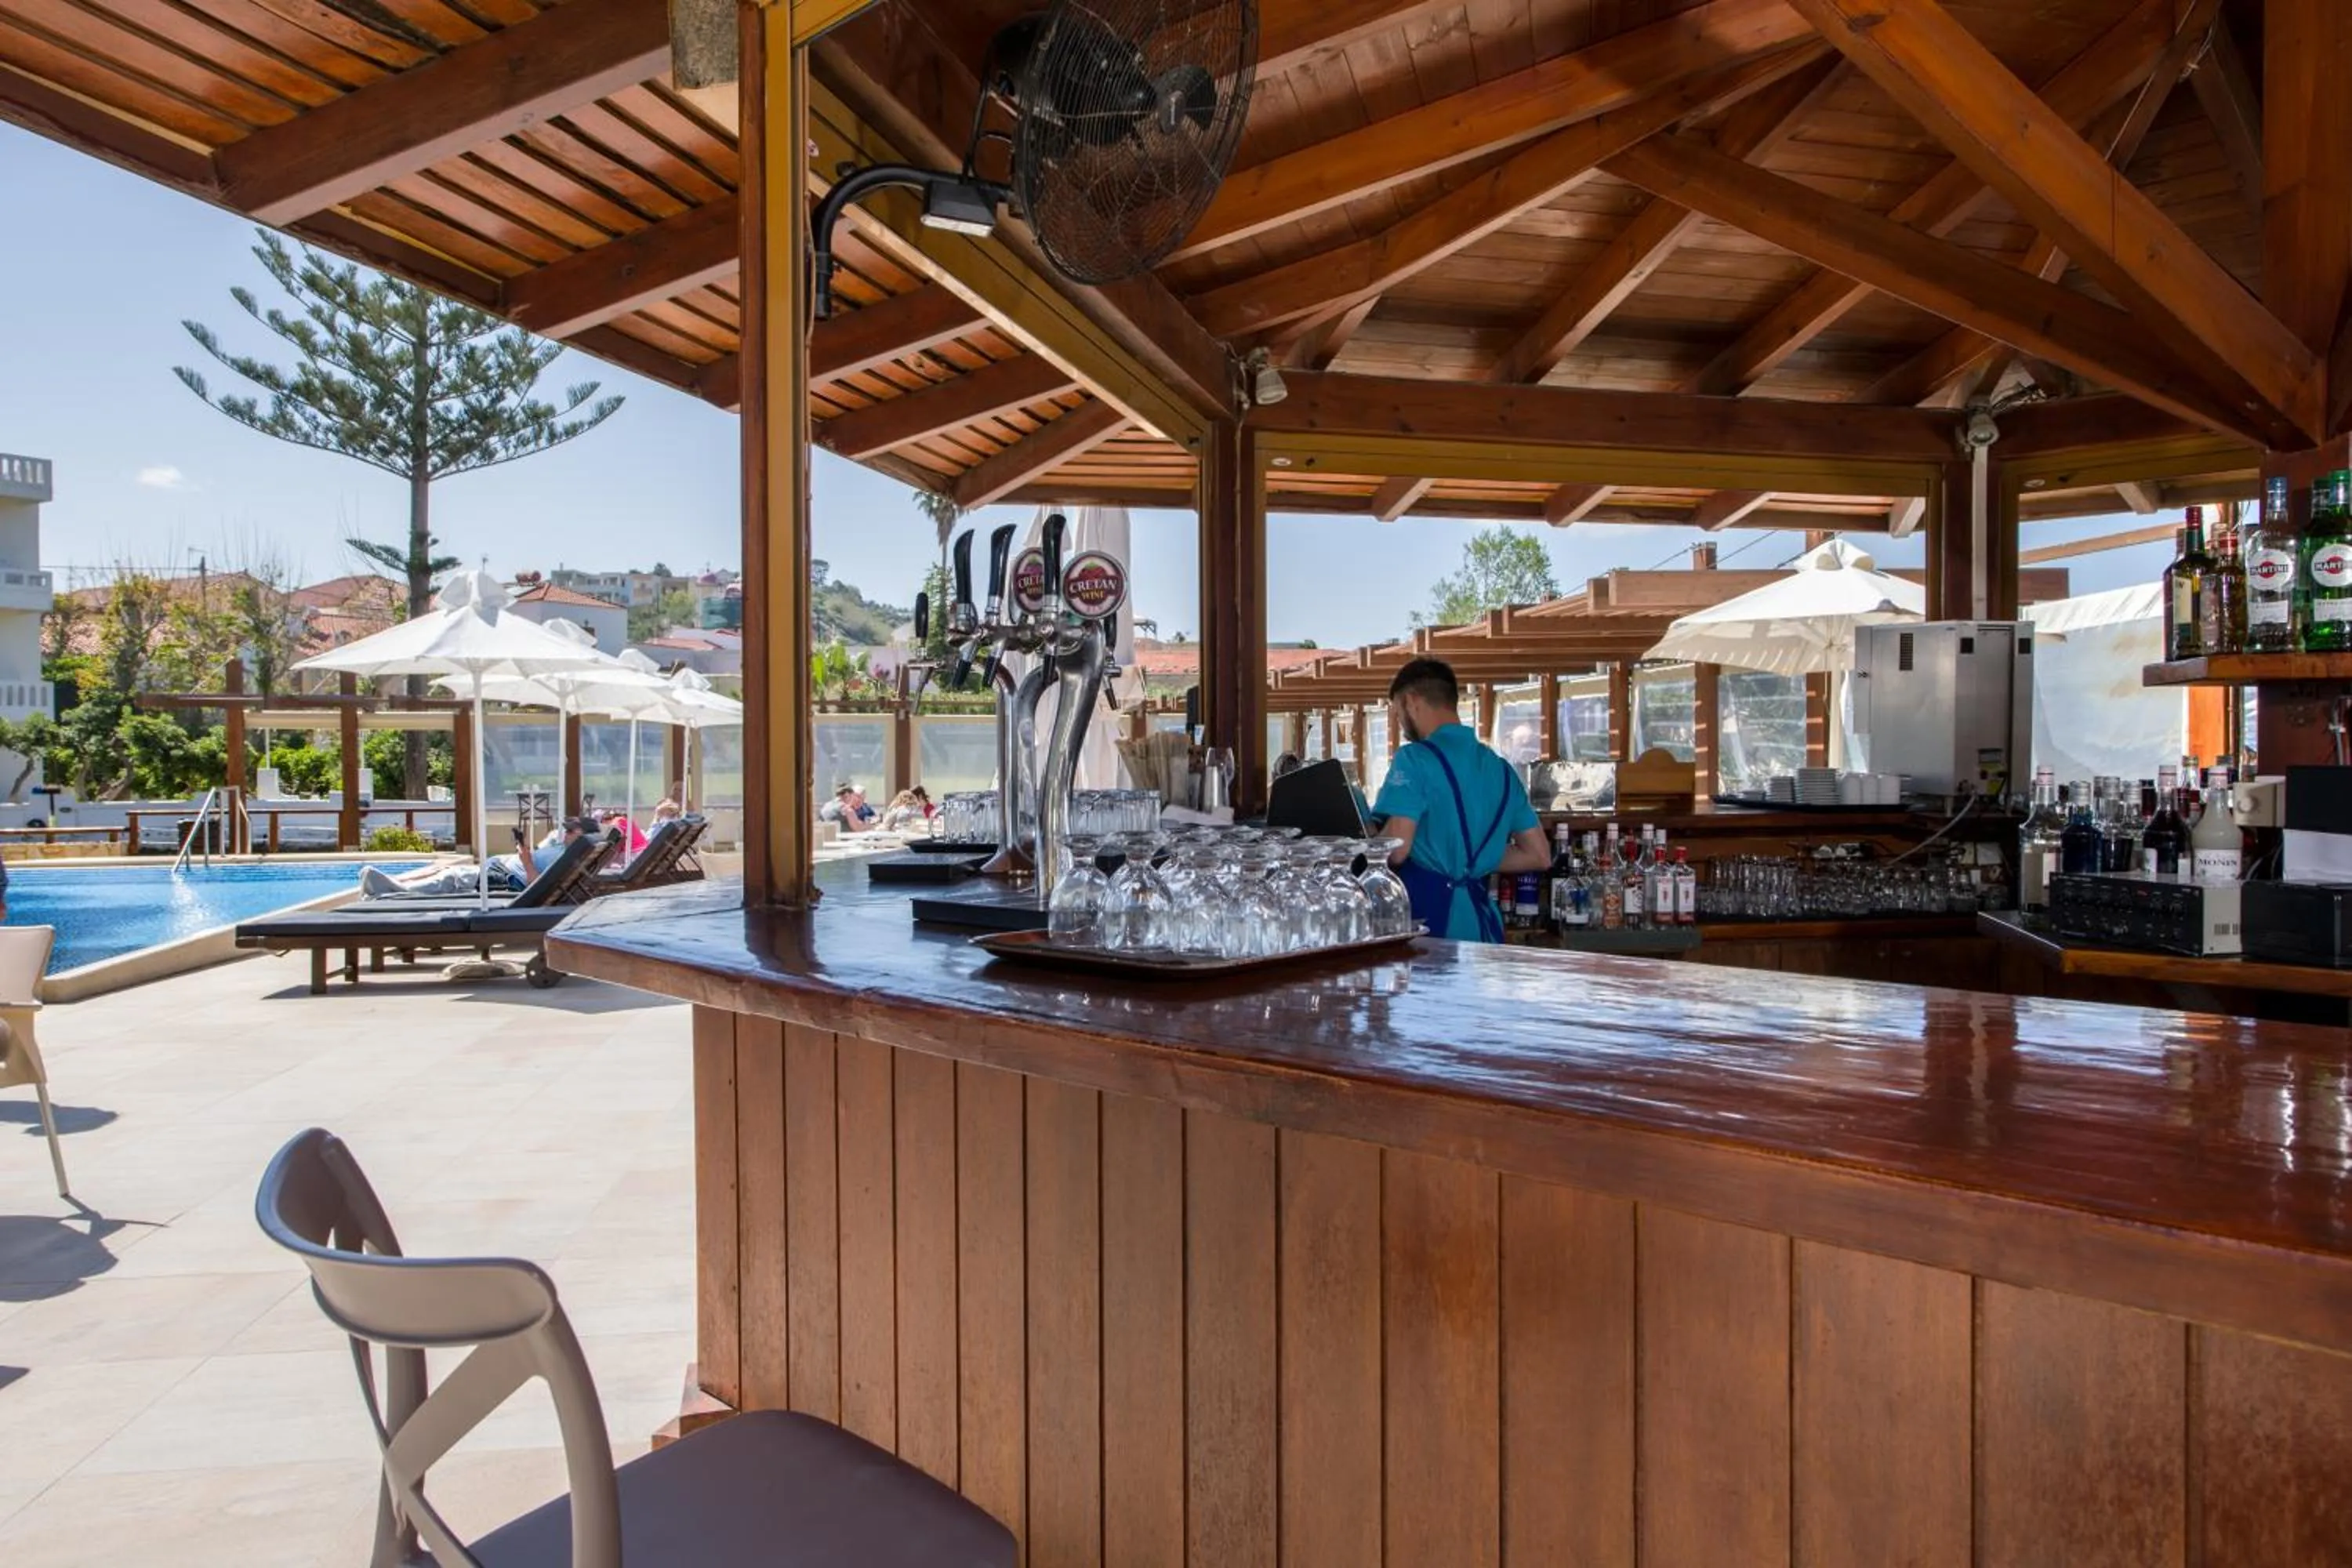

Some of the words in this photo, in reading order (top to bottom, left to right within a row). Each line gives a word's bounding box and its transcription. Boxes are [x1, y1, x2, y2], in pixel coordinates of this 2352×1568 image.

[2249, 564, 2289, 575] MARTINI
[2314, 561, 2343, 572] MART
[1069, 579, 1117, 594] CRETAN
[1081, 589, 1105, 601] WINE
